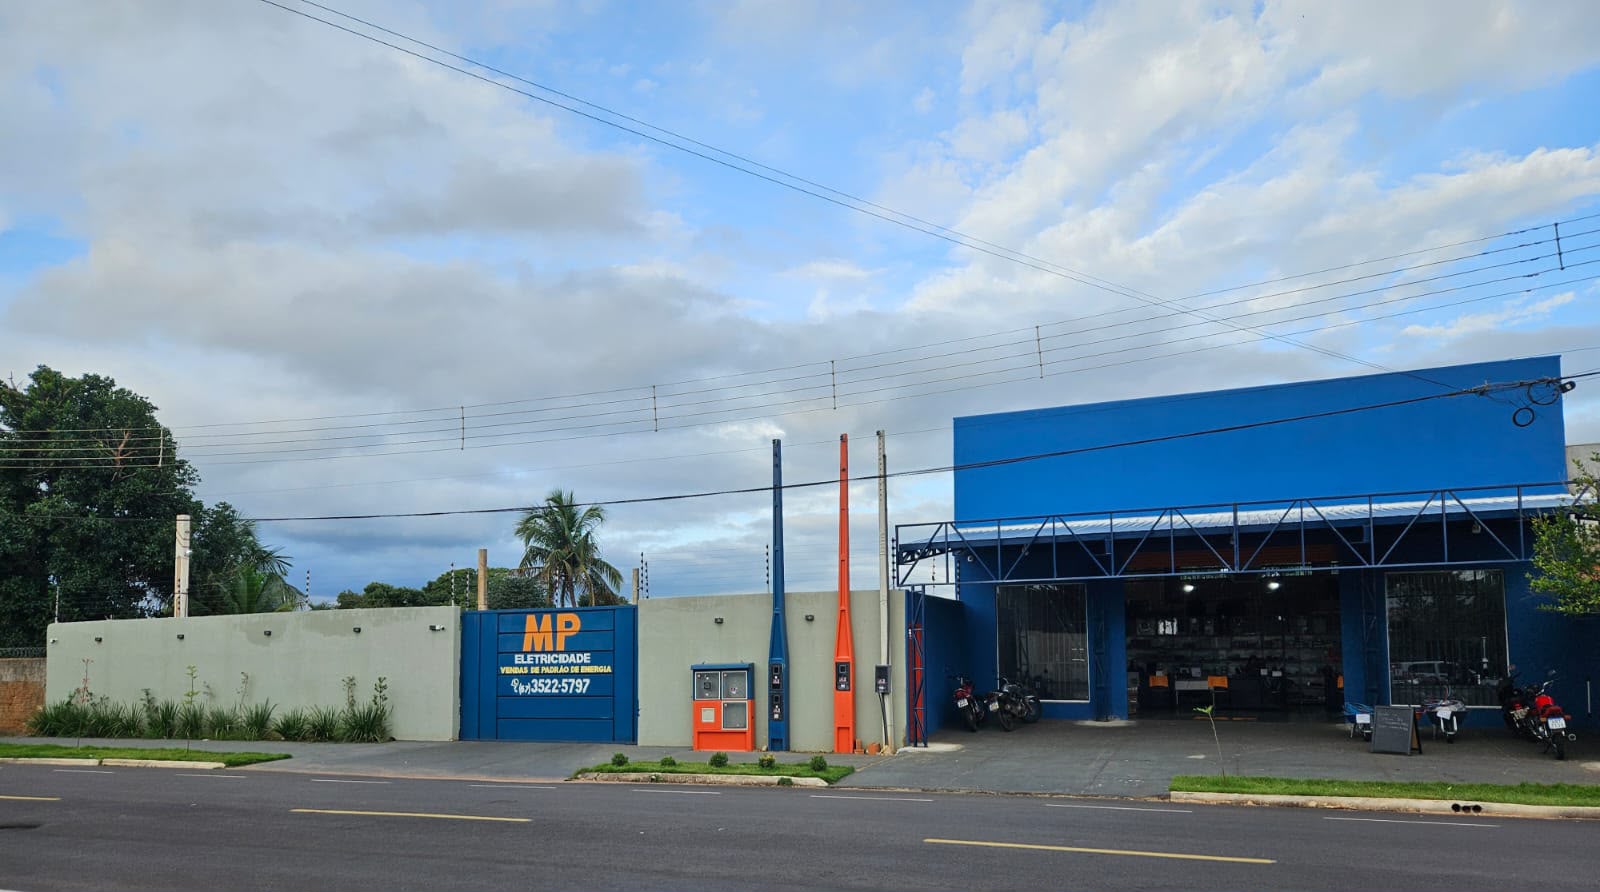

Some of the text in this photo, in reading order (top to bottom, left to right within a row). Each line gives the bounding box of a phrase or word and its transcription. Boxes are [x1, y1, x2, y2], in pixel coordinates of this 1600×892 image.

[523, 613, 581, 652] MP
[514, 653, 591, 665] ELETRICIDADE
[500, 667, 528, 675] VENDAS
[531, 666, 539, 674] DE
[581, 665, 612, 673] ENERGIA
